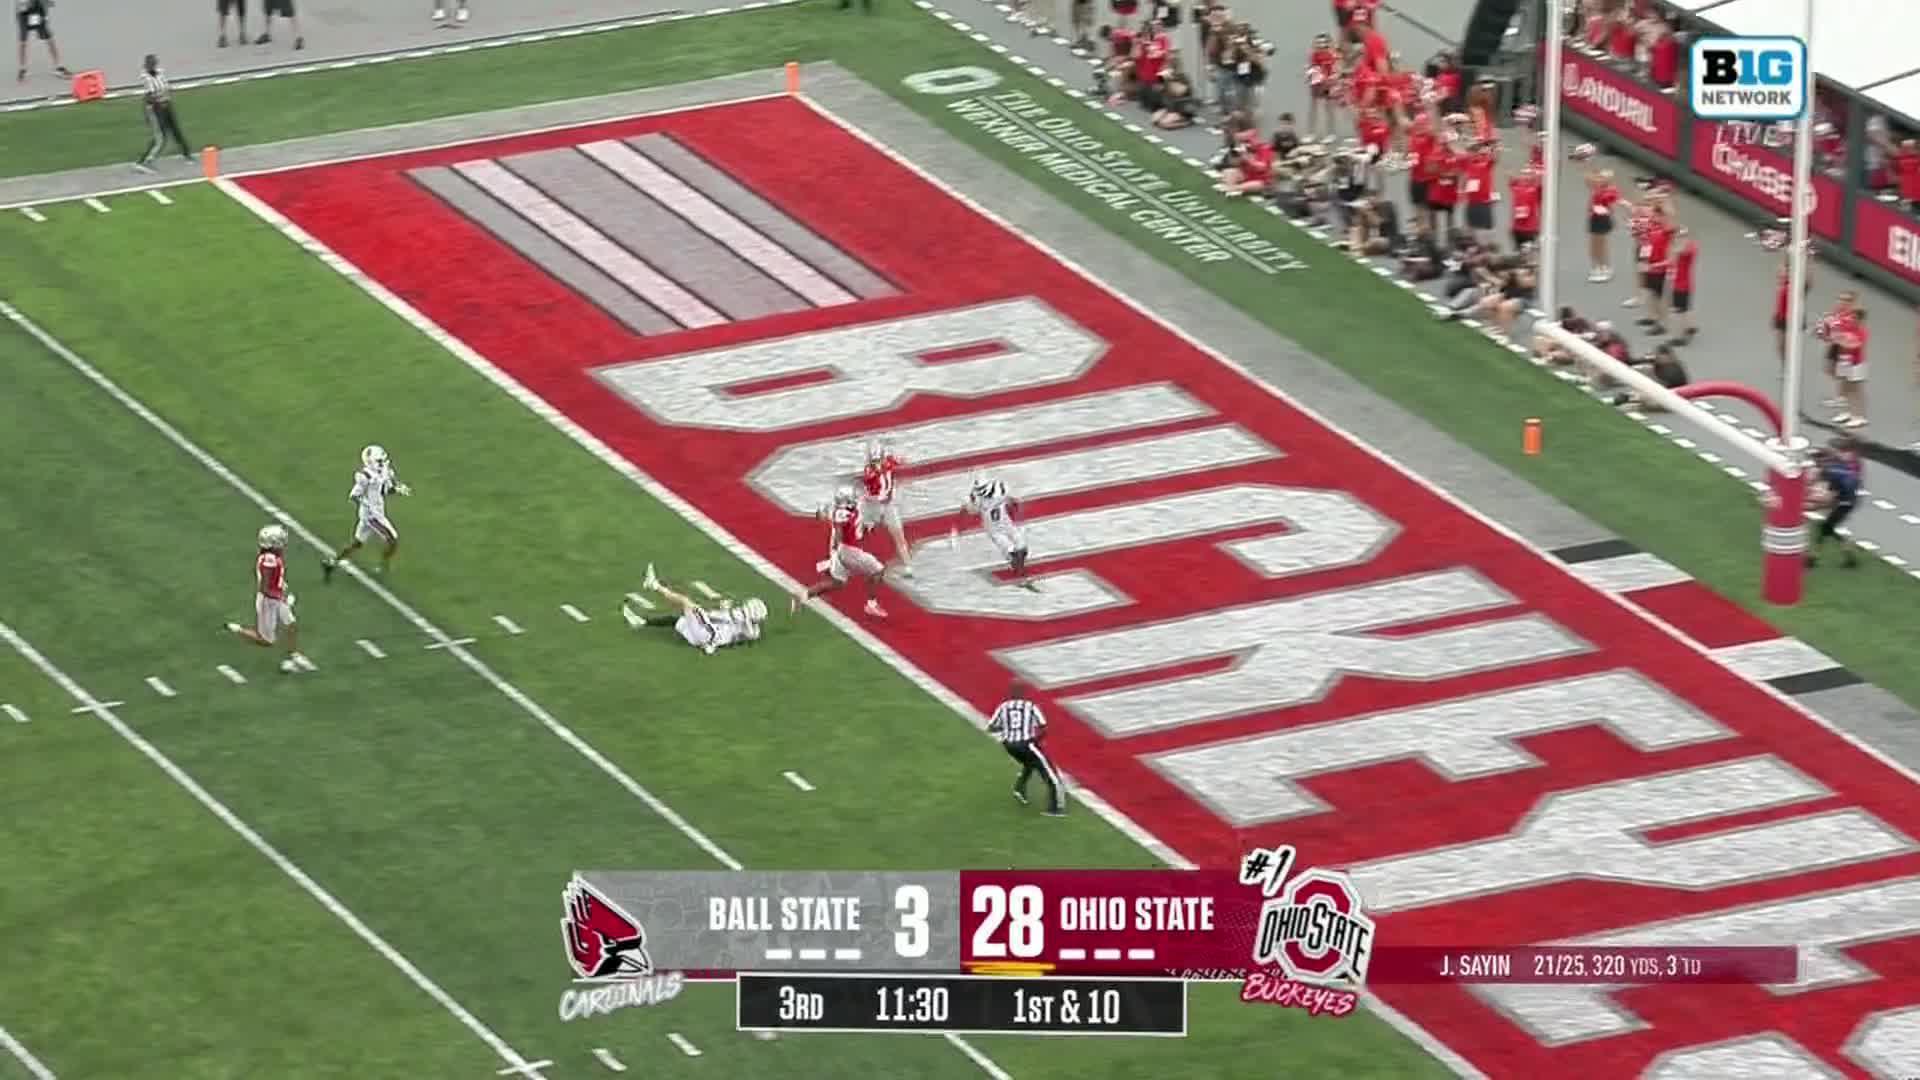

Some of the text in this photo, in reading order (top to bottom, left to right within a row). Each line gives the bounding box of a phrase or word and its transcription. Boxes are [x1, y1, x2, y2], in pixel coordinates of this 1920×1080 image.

[946, 98, 1233, 264] WEXNER MEDICAL CENTER
